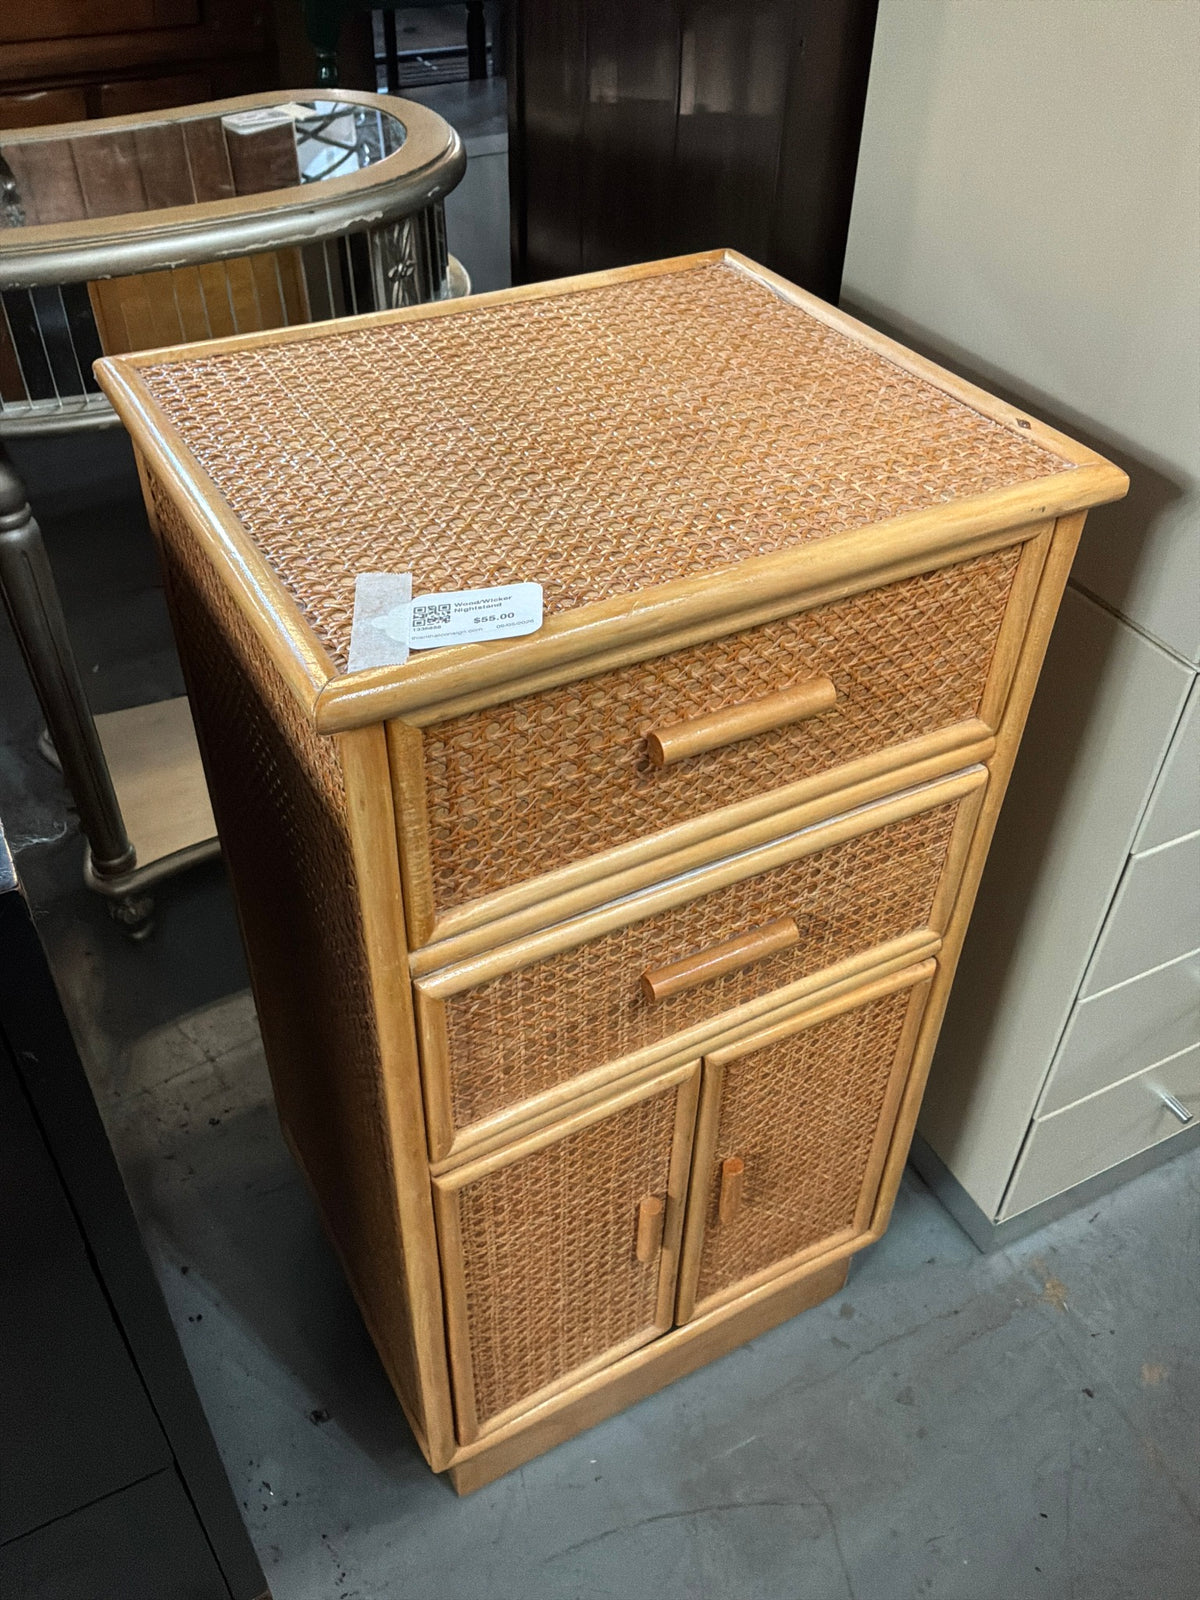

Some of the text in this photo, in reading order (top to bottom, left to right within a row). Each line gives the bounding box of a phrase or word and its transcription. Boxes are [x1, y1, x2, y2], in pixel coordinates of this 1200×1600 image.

[453, 602, 502, 613] Nightstand
[454, 596, 513, 608] Wood/Wicker
[473, 612, 515, 624] $55.00
